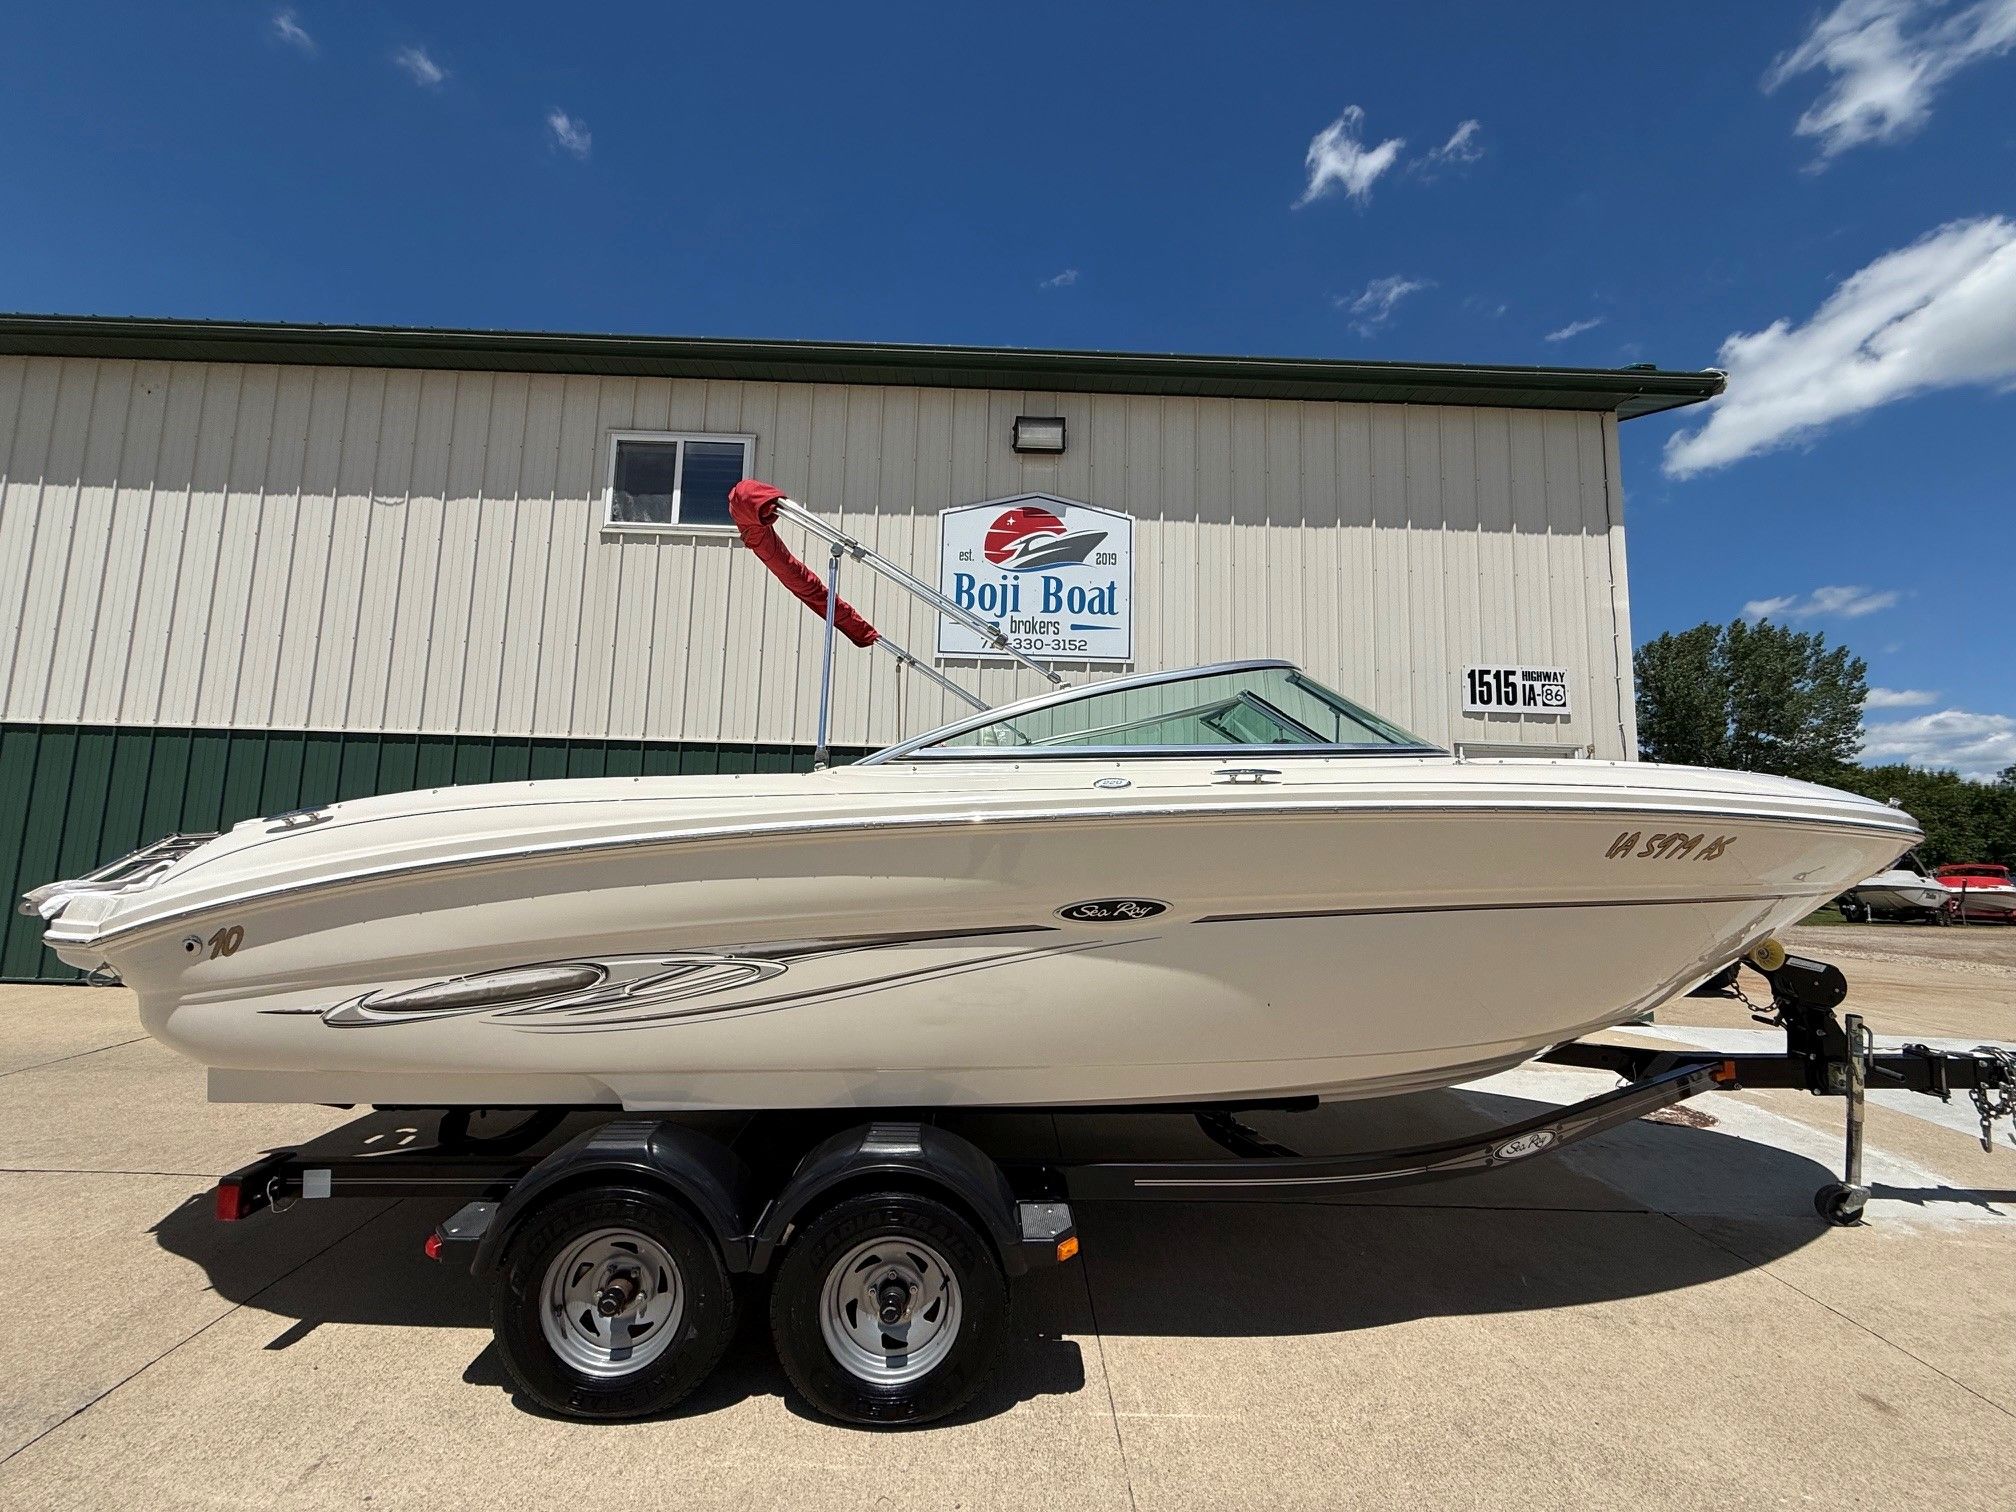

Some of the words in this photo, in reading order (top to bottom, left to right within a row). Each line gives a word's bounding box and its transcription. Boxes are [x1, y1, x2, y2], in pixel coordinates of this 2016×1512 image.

[959, 549, 975, 562] est.
[1095, 552, 1117, 566] 2019
[953, 572, 1021, 618] Boji
[1040, 575, 1119, 616] Boat
[1009, 615, 1060, 636] brokers
[981, 637, 1088, 652] 7-330-3152
[1521, 670, 1565, 683] HIGHWAY
[1467, 669, 1518, 706] 1515
[1604, 831, 1641, 859] IA
[1691, 835, 1737, 861] AS
[1072, 905, 1112, 918] Sea
[1112, 901, 1153, 918] Ray
[1506, 1141, 1526, 1155] Sea
[1527, 1133, 1548, 1149] Ray
